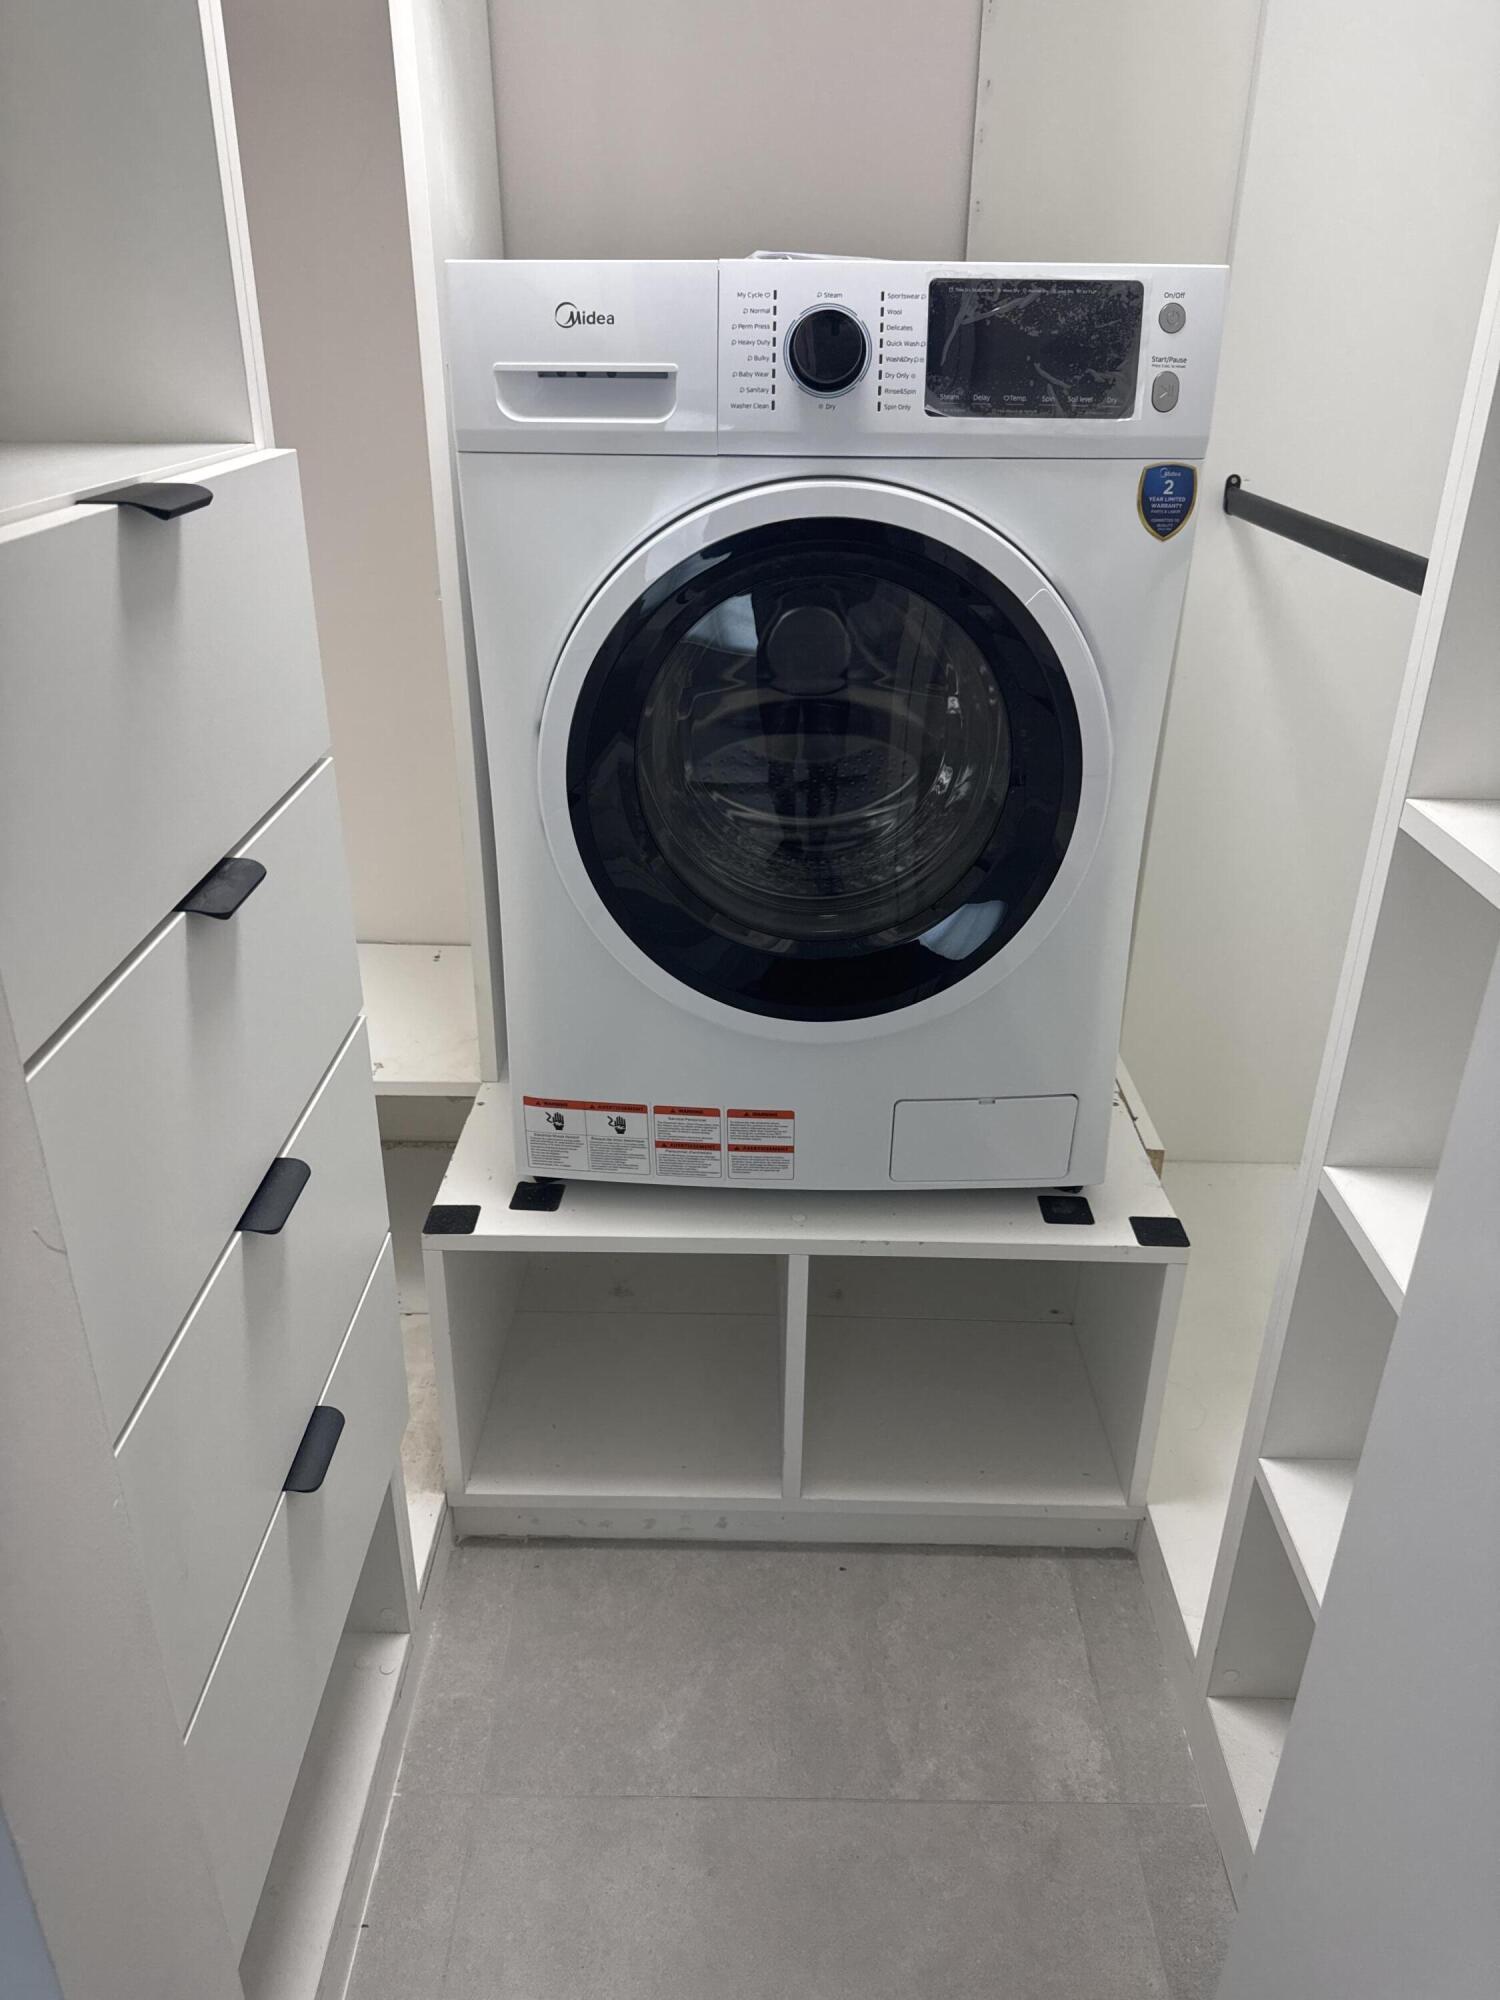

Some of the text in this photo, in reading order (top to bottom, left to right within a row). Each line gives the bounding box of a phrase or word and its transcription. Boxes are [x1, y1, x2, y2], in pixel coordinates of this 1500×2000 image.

[737, 291, 763, 299] My Cycle
[823, 291, 843, 299] Steam
[887, 292, 920, 300] Sportswear
[1163, 291, 1186, 299] On/Off
[554, 301, 615, 329] Midea
[738, 339, 771, 347] Heavy Duty
[886, 356, 913, 364] Wash&Dry
[1151, 355, 1187, 364] Start/Pause
[746, 386, 769, 394] Sanitary
[884, 387, 916, 395] Rinse&Spin
[939, 393, 960, 401] Steam
[973, 393, 991, 402] Delay
[825, 403, 836, 411] Dry
[1163, 480, 1175, 495] 2
